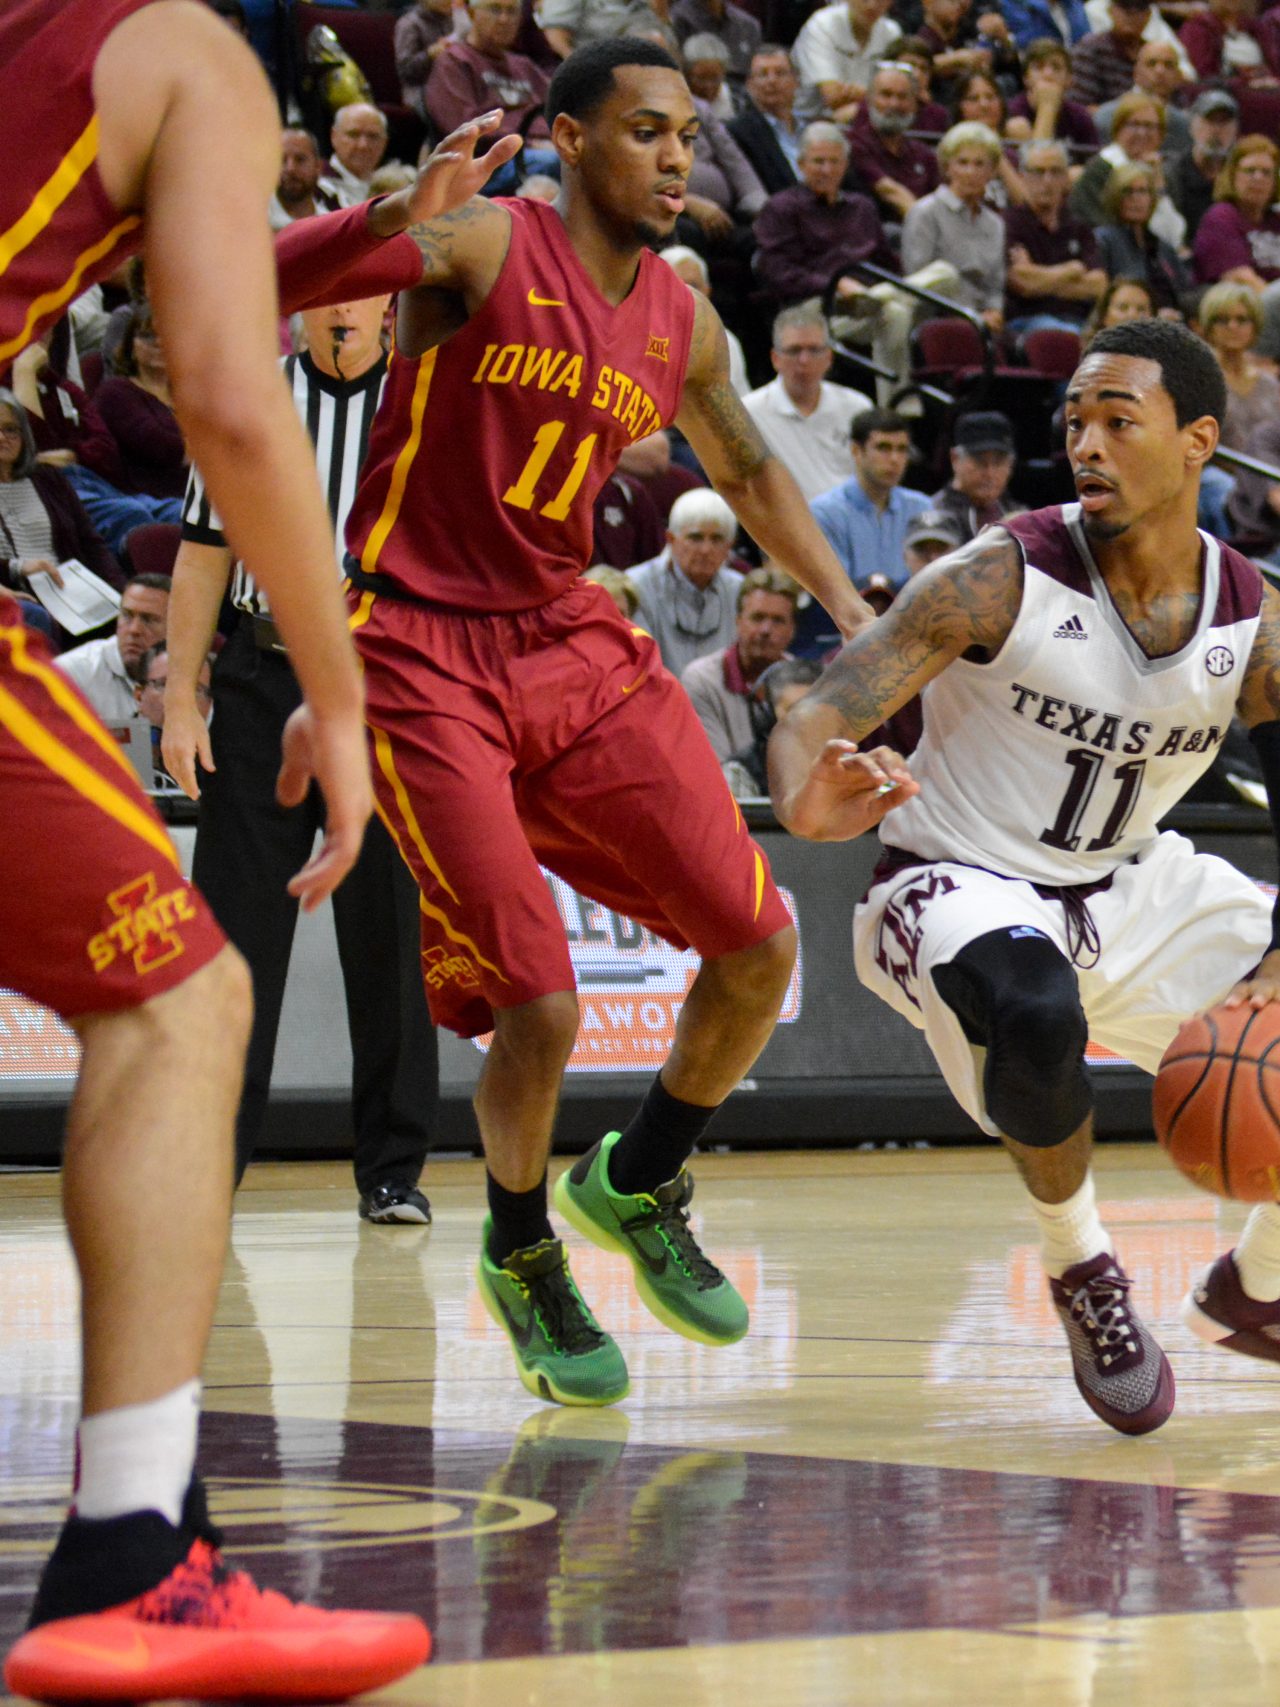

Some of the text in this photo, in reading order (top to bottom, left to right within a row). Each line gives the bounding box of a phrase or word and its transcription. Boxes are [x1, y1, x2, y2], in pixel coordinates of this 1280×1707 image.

[472, 344, 584, 398] IOWA
[502, 420, 598, 521] 11
[1053, 630, 1088, 641] adidas
[1011, 683, 1152, 755] TEXAS
[1038, 748, 1147, 852] 11
[87, 887, 196, 972] STATE
